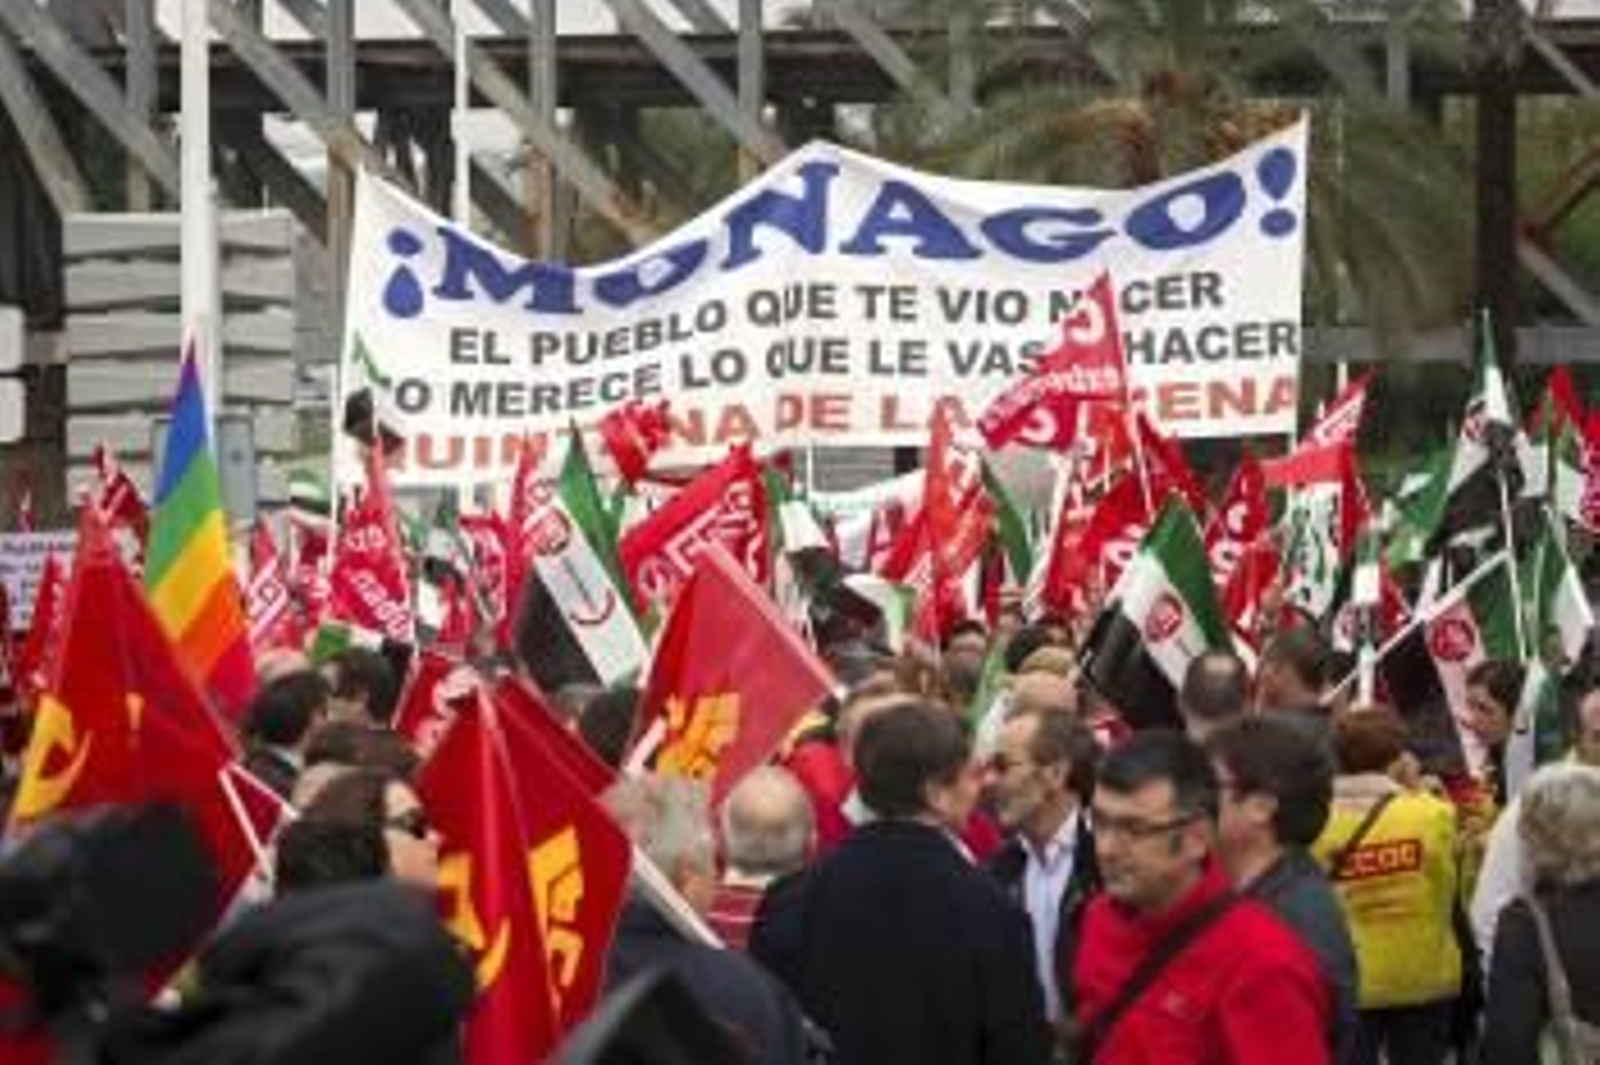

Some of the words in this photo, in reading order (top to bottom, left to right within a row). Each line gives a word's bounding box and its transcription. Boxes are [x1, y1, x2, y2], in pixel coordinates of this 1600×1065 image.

[450, 327, 511, 365] EL
[531, 300, 727, 366] PUEBLO
[746, 283, 838, 327] QUE
[854, 285, 918, 321] TE
[938, 287, 1029, 324] VIO
[1050, 271, 1225, 323] NCER
[450, 362, 662, 418] MERECE
[680, 348, 747, 389] LO
[765, 336, 849, 378] QUE
[868, 340, 928, 376] LE
[1122, 321, 1296, 365] HACER
[774, 393, 852, 433] DE
